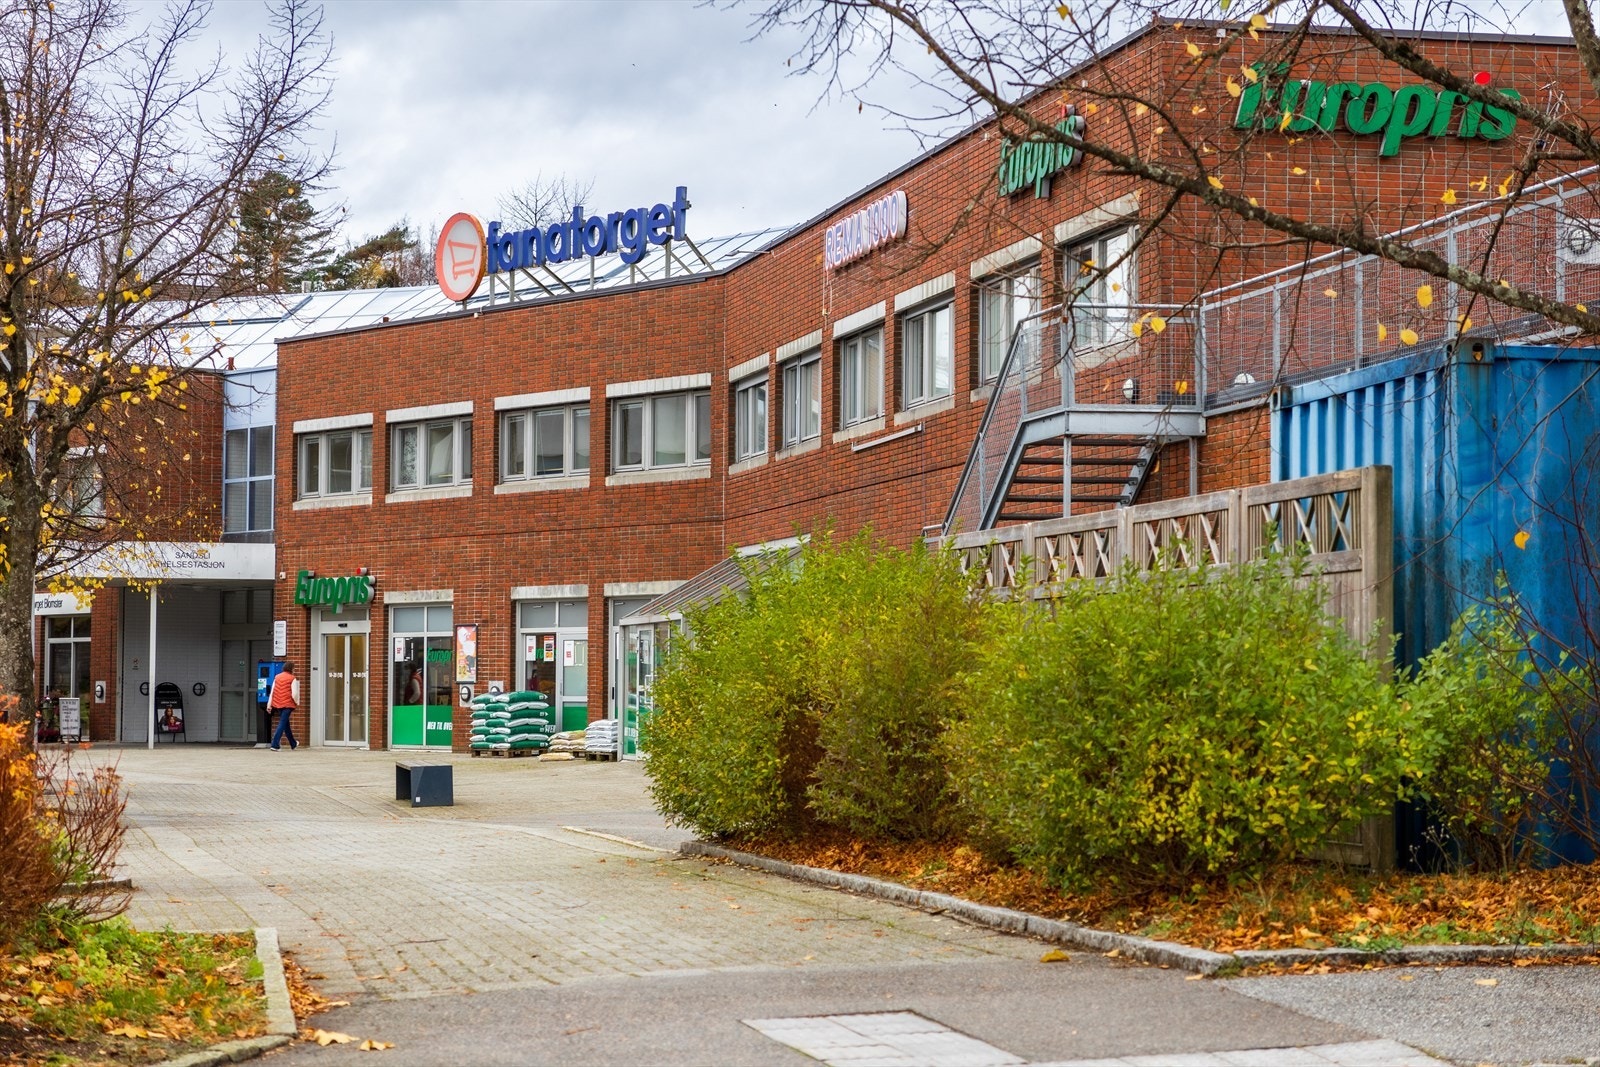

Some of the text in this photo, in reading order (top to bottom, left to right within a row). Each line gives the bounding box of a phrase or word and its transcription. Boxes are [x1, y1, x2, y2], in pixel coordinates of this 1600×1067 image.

[1234, 62, 1521, 157] Europris
[999, 105, 1084, 199] Europris
[486, 186, 690, 274] fanatorget
[825, 190, 906, 270] REMA 1000
[160, 560, 225, 569] HELSESTASJON
[175, 551, 211, 559] SANDSLI
[34, 598, 64, 611] rget Blomster
[295, 567, 375, 614] Europris
[427, 647, 453, 666] Europr
[443, 722, 453, 731] OVE
